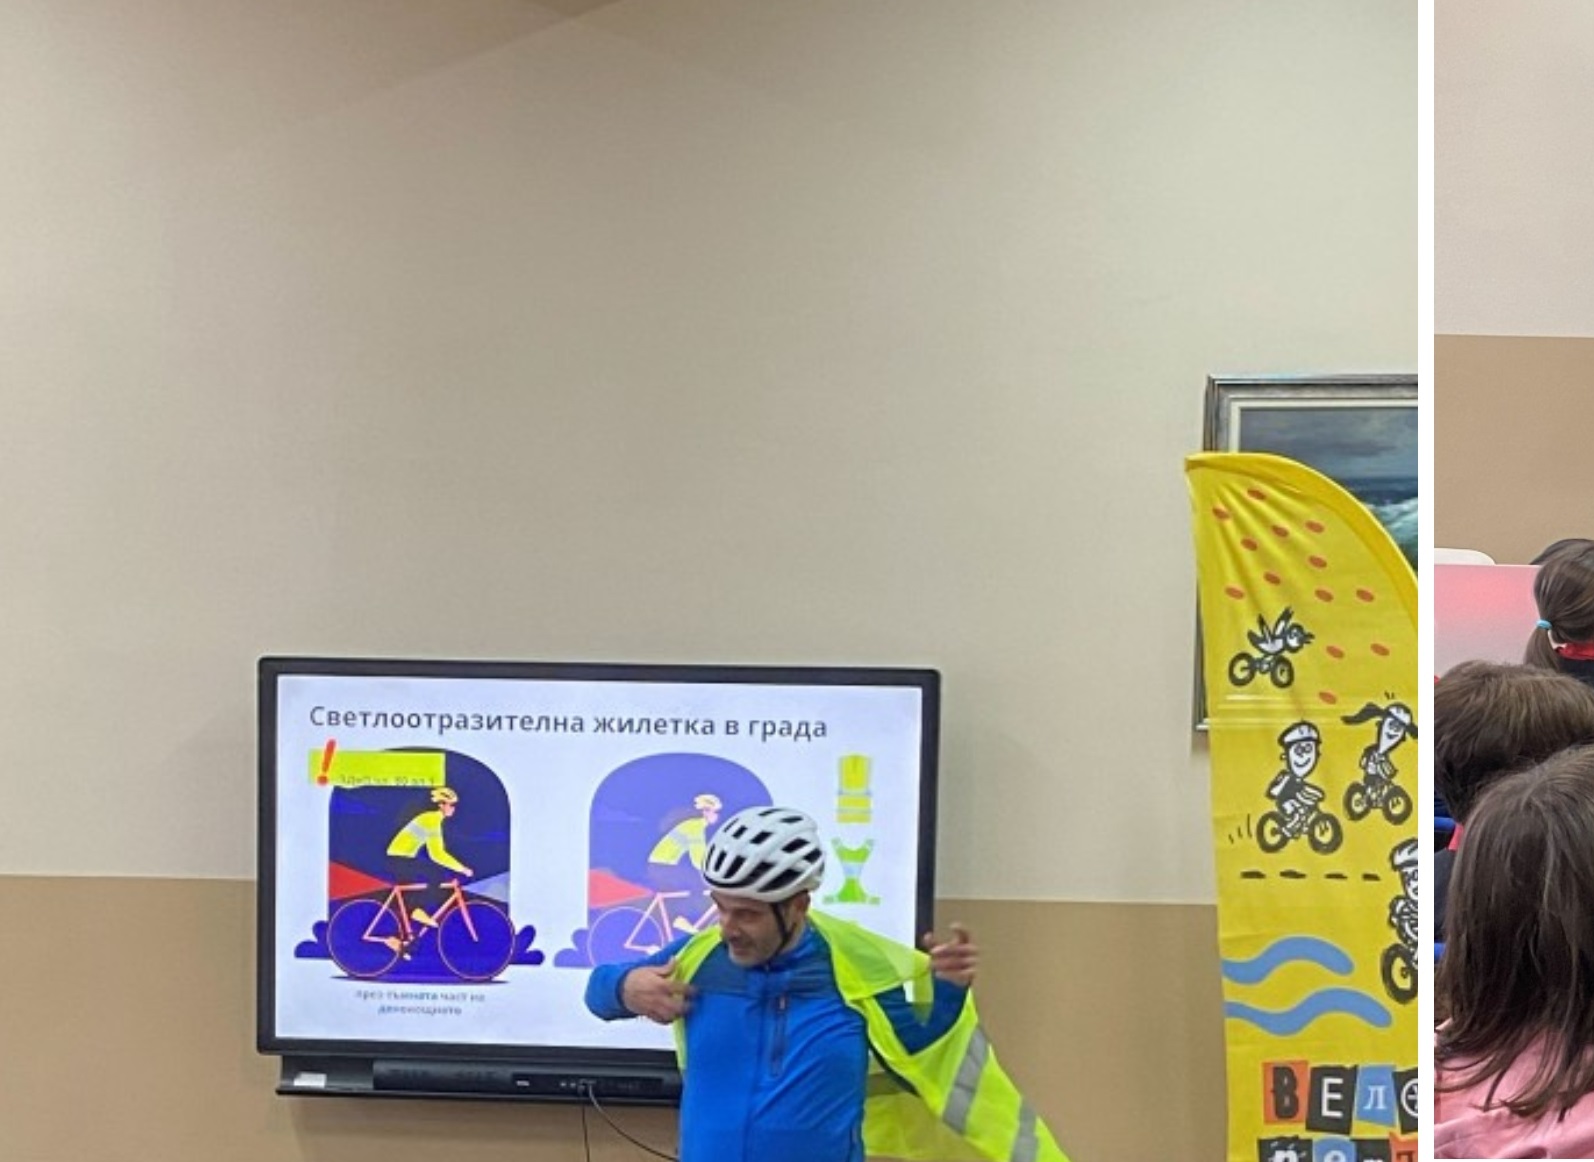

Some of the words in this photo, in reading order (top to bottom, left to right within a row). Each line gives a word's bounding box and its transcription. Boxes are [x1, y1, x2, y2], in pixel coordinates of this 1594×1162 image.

[309, 705, 584, 736] Светлоотразителна
[593, 715, 715, 736] жилетка
[725, 719, 740, 735] в
[749, 719, 827, 742] града
